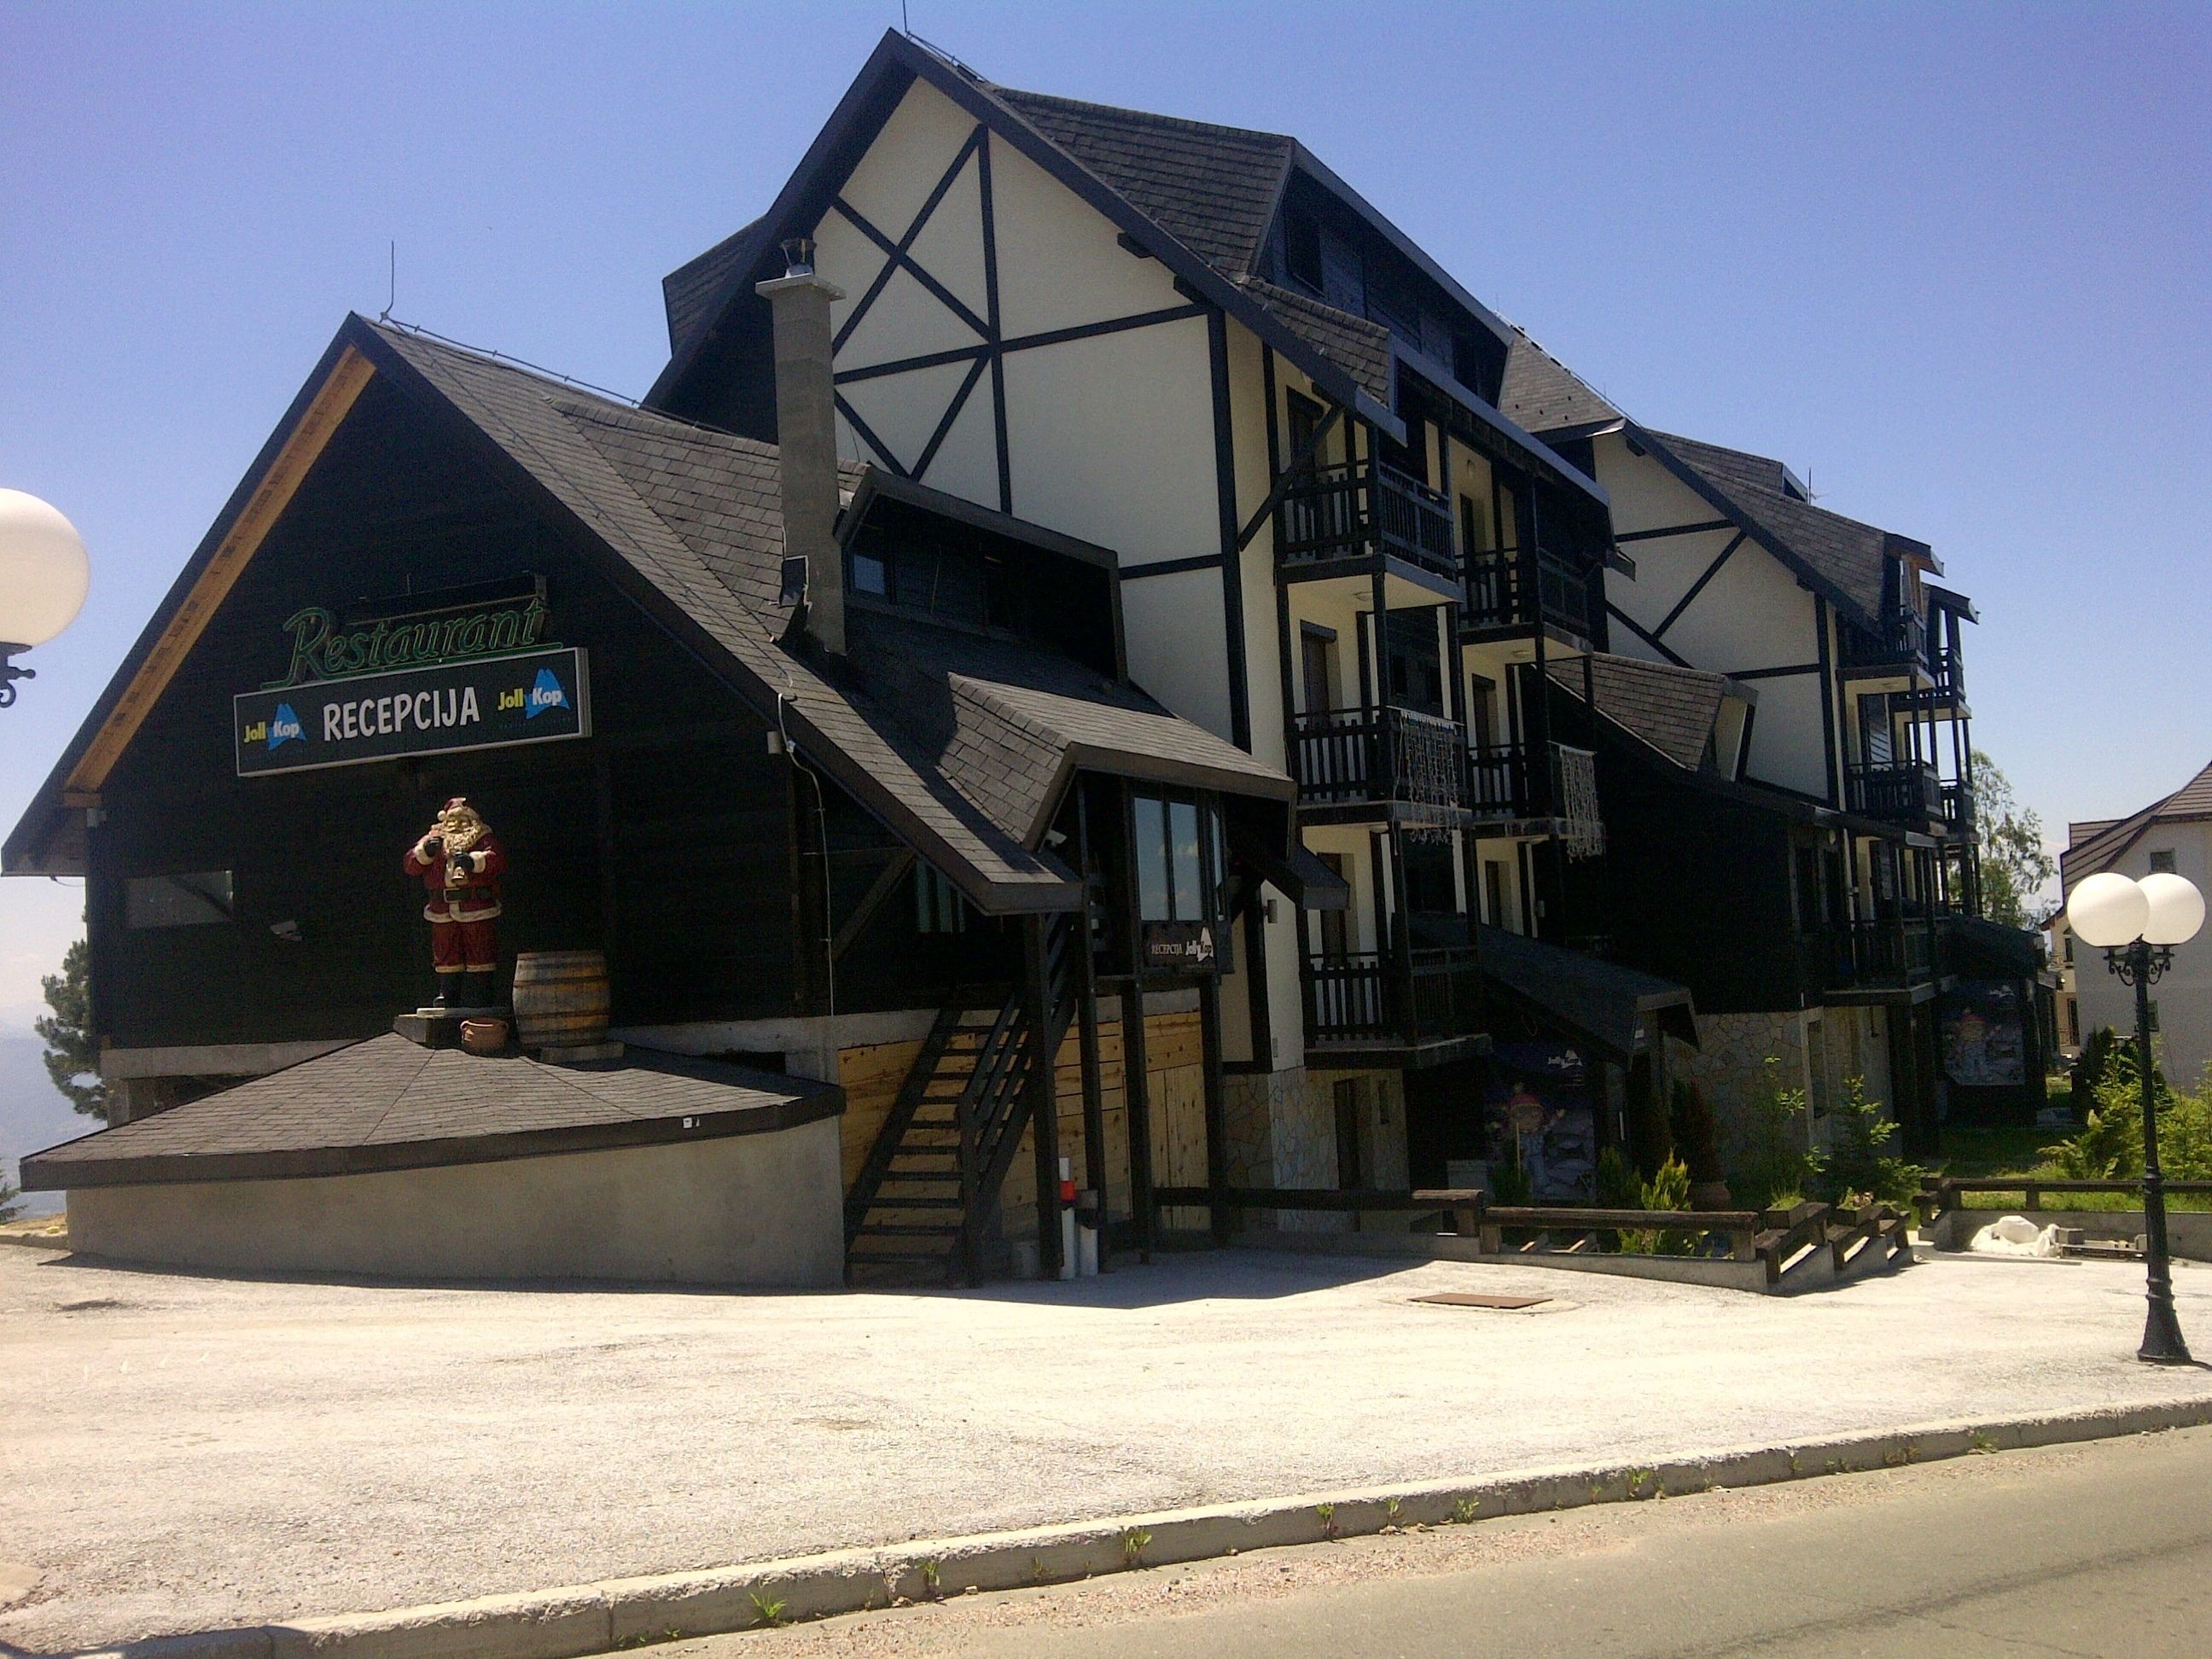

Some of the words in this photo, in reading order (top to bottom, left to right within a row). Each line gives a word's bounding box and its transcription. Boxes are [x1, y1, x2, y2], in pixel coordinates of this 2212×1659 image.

[261, 598, 546, 688] Restaurant
[273, 720, 300, 738] Kop
[323, 686, 480, 742] RECEPCIJA
[532, 687, 563, 707] Kop
